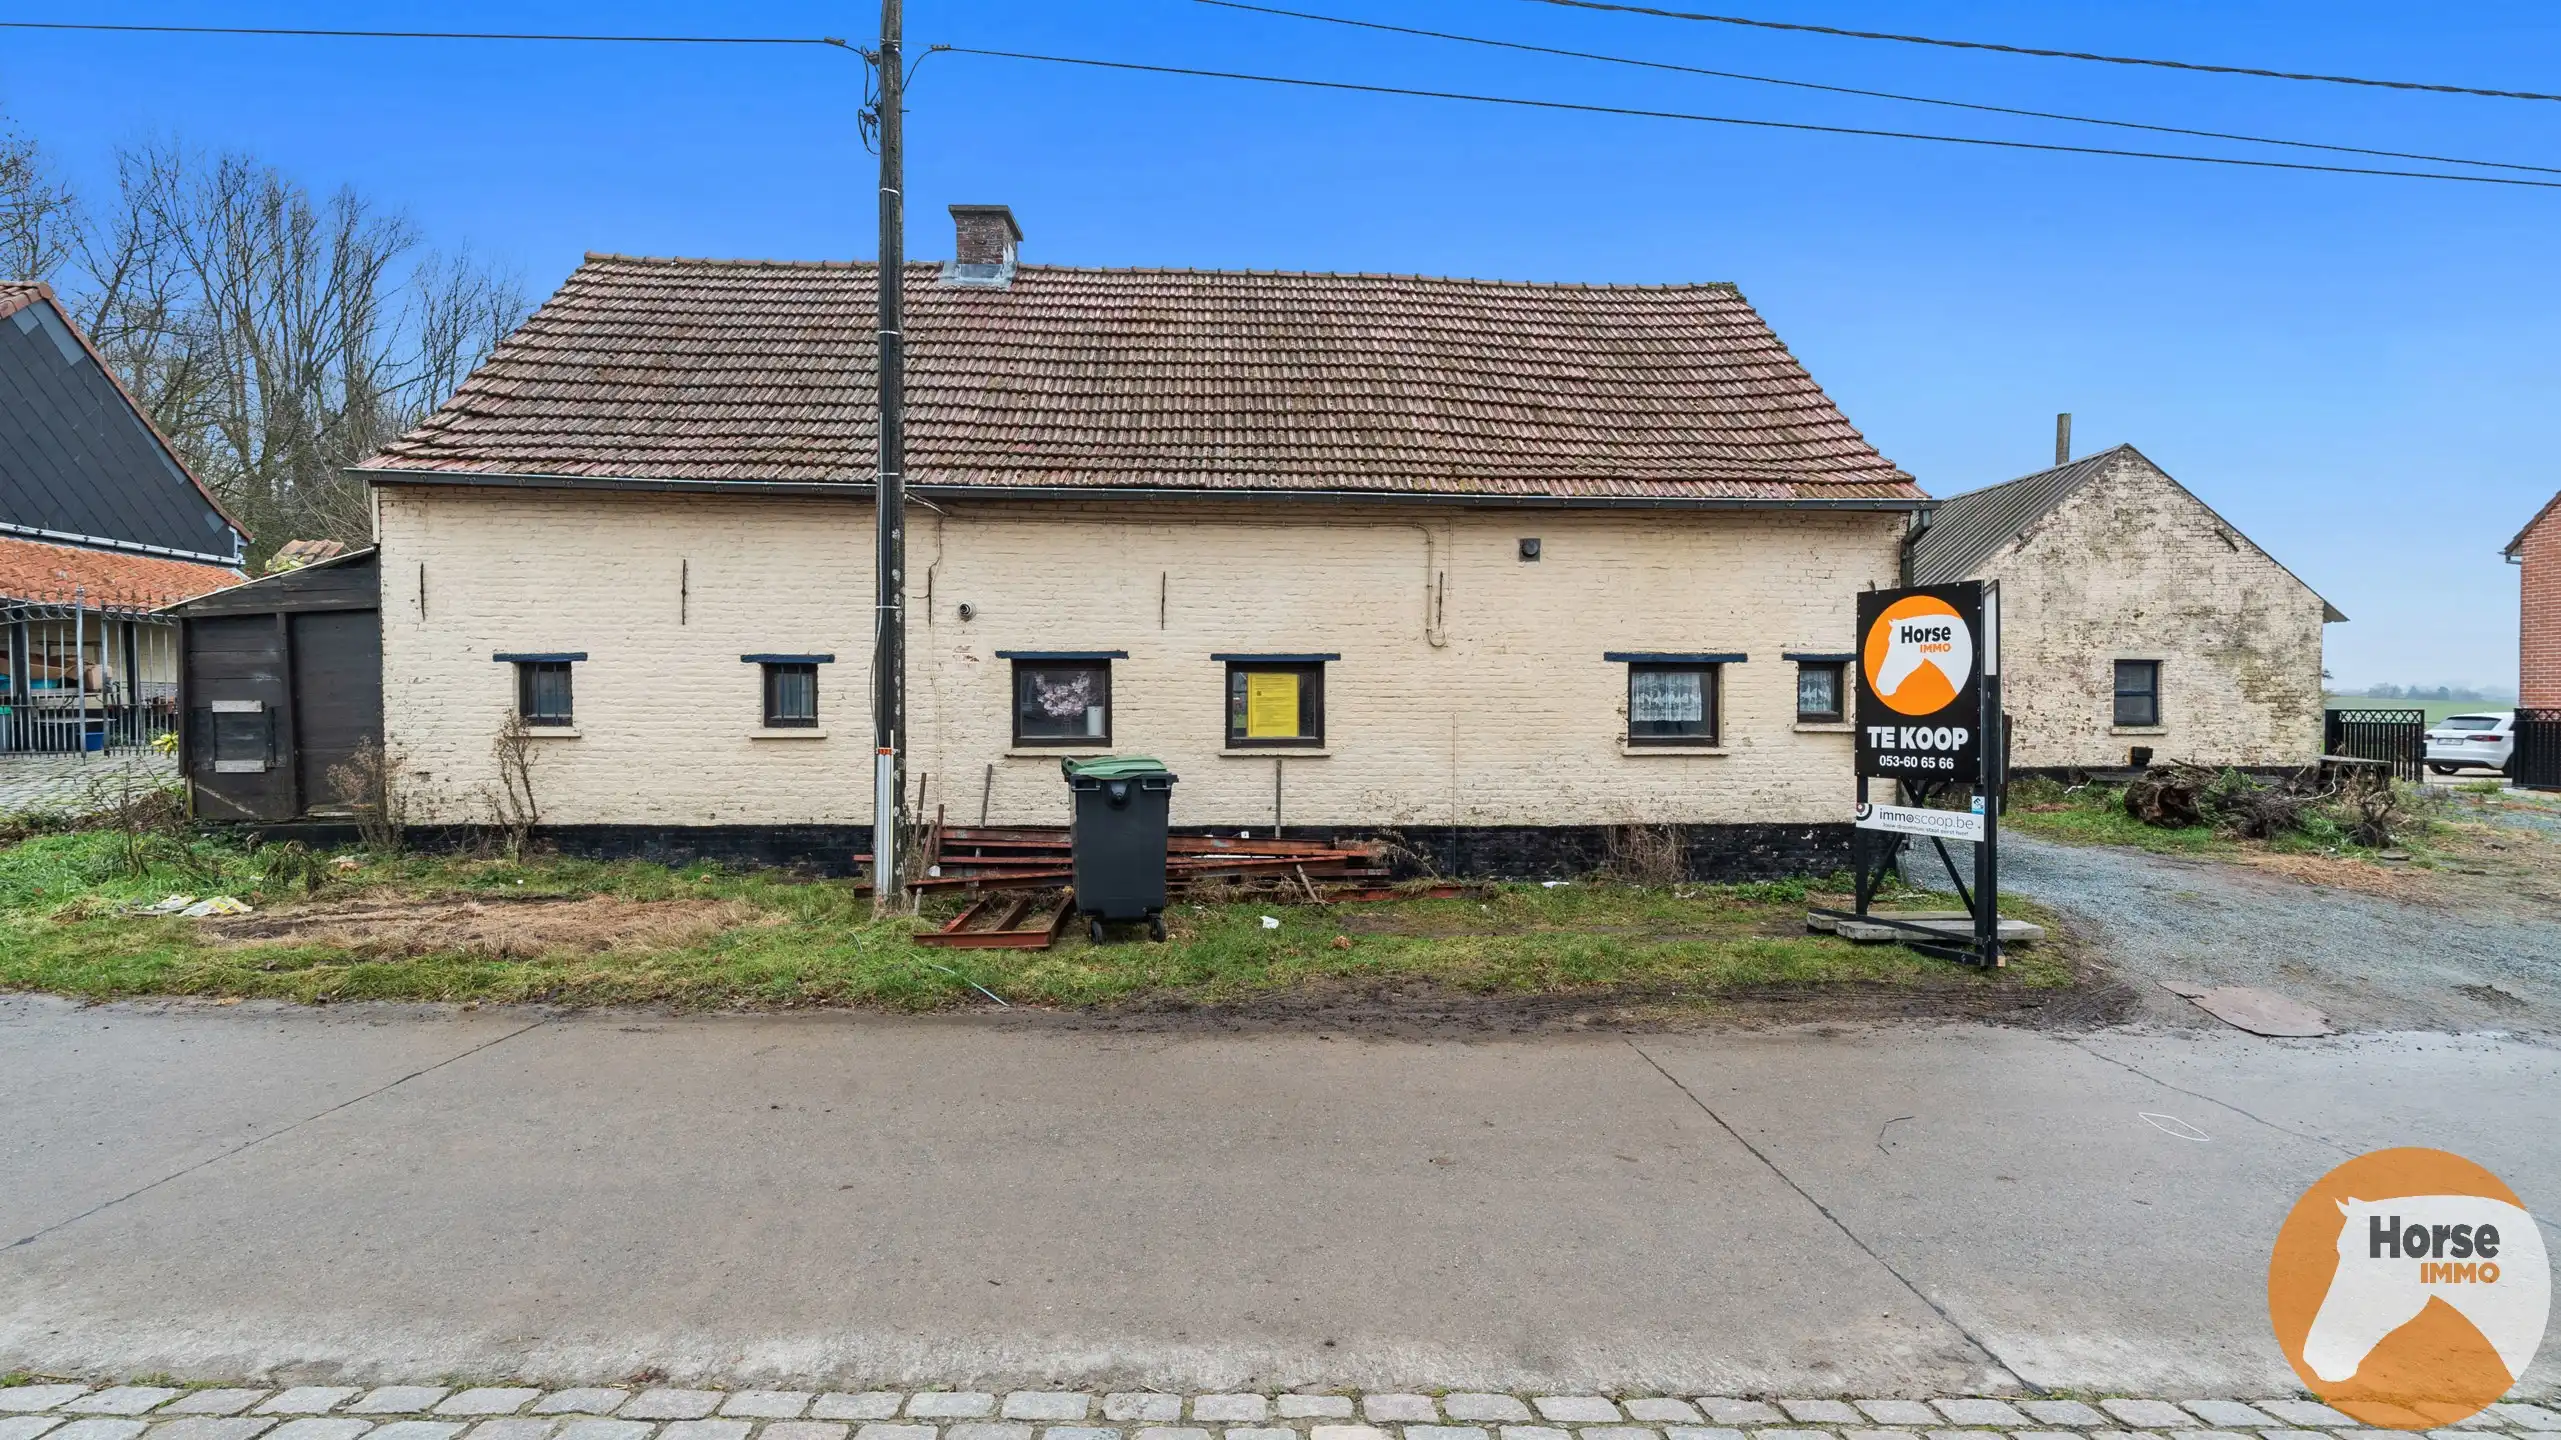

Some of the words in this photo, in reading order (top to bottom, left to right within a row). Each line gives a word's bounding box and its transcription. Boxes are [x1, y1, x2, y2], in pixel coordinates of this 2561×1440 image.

[1901, 625, 1951, 643] Horse
[1920, 643, 1951, 653] IMMO
[1867, 726, 1896, 748] TE
[1900, 726, 1969, 751] KOOP
[1879, 755, 1918, 768] 053-60
[1921, 757, 1936, 769] 65
[1938, 758, 1954, 770] 66
[1879, 808, 1974, 830] immoscoop.be
